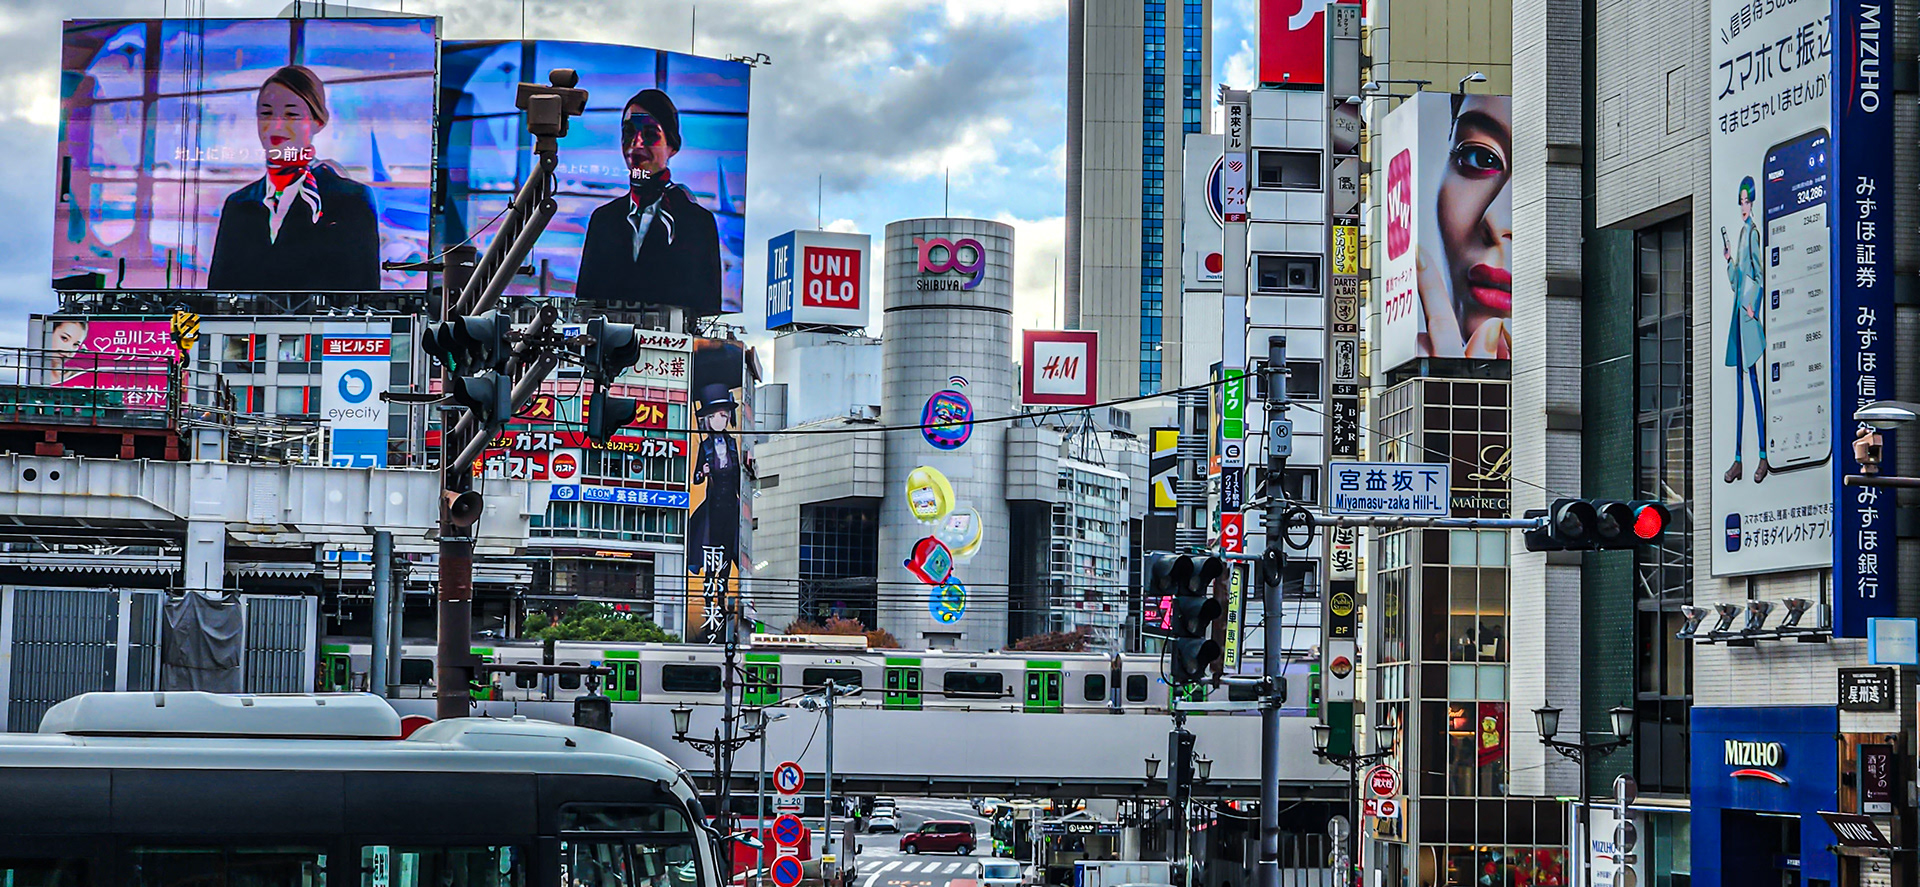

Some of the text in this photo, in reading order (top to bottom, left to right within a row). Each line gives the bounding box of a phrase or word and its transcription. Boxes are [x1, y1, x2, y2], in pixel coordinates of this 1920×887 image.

[1860, 3, 1880, 113] MIZUHO
[1855, 176, 1877, 288] みずほ証券
[774, 245, 787, 277] THE
[809, 254, 850, 277] UNI
[913, 237, 986, 291] 109
[808, 278, 854, 302] QLO
[916, 280, 960, 291] SHIBUYA
[767, 279, 792, 317] PRIME
[113, 330, 176, 345] 品川スキ
[329, 340, 384, 353] 当ビル5F
[633, 357, 686, 377] しゃぶ葉
[1042, 356, 1079, 380] H&M
[1226, 375, 1240, 411] レイク
[328, 407, 380, 421] eyecity
[1334, 402, 1344, 446] カラオケ
[1347, 408, 1356, 441] BAR
[515, 431, 563, 451] ガスト
[641, 439, 680, 459] ガスト
[1339, 446, 1351, 454] 4F
[485, 456, 545, 480] ガスト
[555, 464, 575, 472] ガスト
[1339, 469, 1440, 492] 宮益坂下
[559, 486, 574, 499] 6F
[586, 487, 688, 506] AEON 英会話イーオン
[1336, 494, 1442, 512] Miyamasu-zaka Hill-L.
[1451, 496, 1495, 509] MAÎTRE
[1857, 485, 1879, 598] みずほ銀行
[1725, 739, 1779, 767] MIZUHO
[1877, 754, 1887, 788] ワインの
[1833, 821, 1879, 841] WINE
